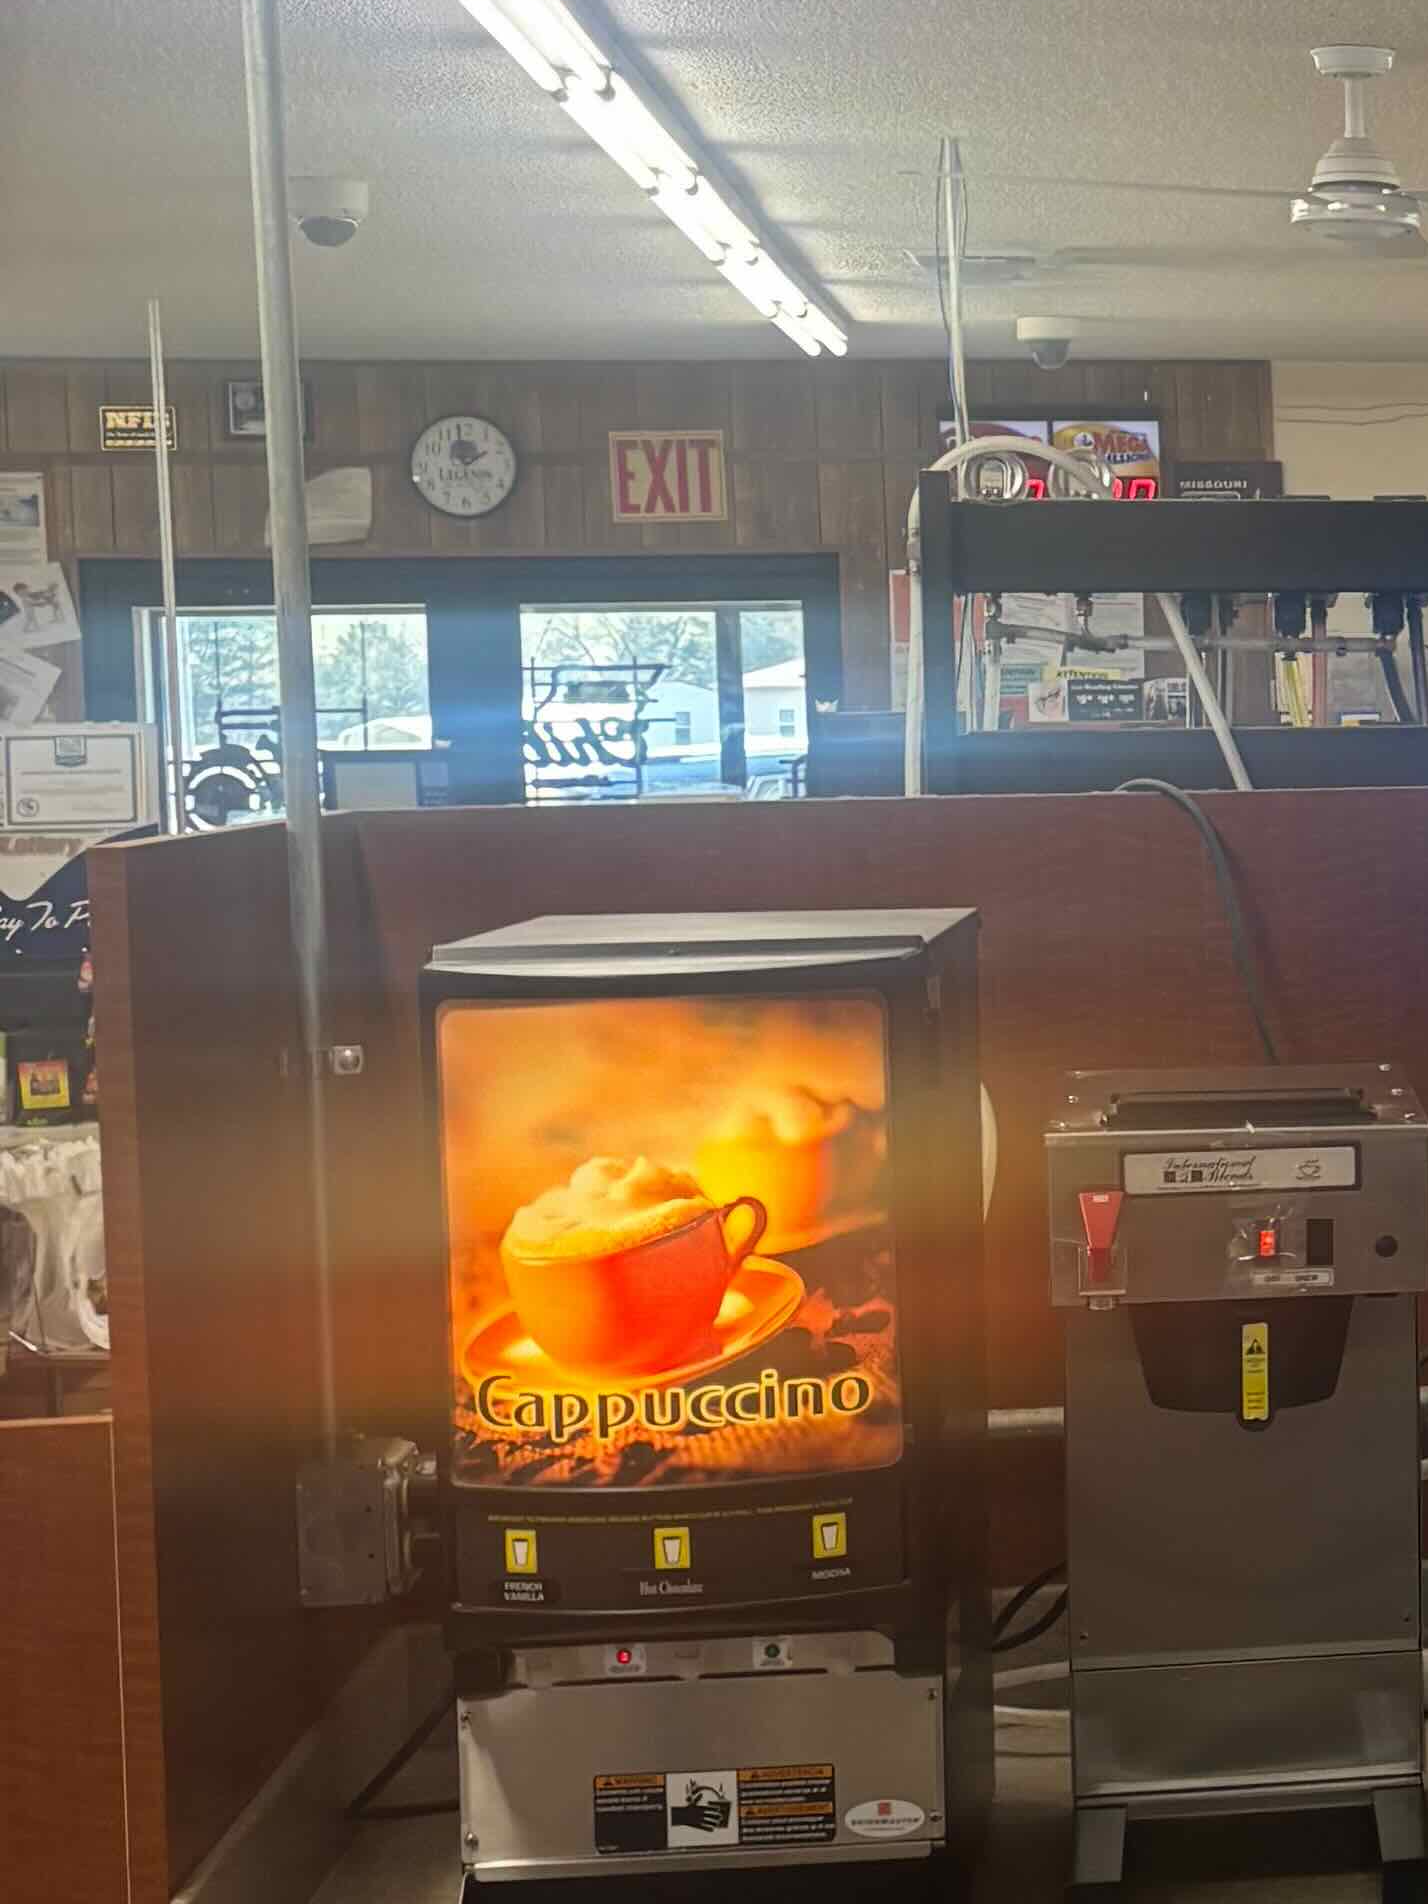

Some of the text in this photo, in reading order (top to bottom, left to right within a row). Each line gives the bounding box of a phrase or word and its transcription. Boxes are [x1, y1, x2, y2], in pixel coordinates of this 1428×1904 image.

[616, 439, 720, 514] EXIT
[1179, 479, 1248, 490] MISSOURI
[26, 900, 60, 932] To
[476, 1370, 871, 1441] Cappuccino
